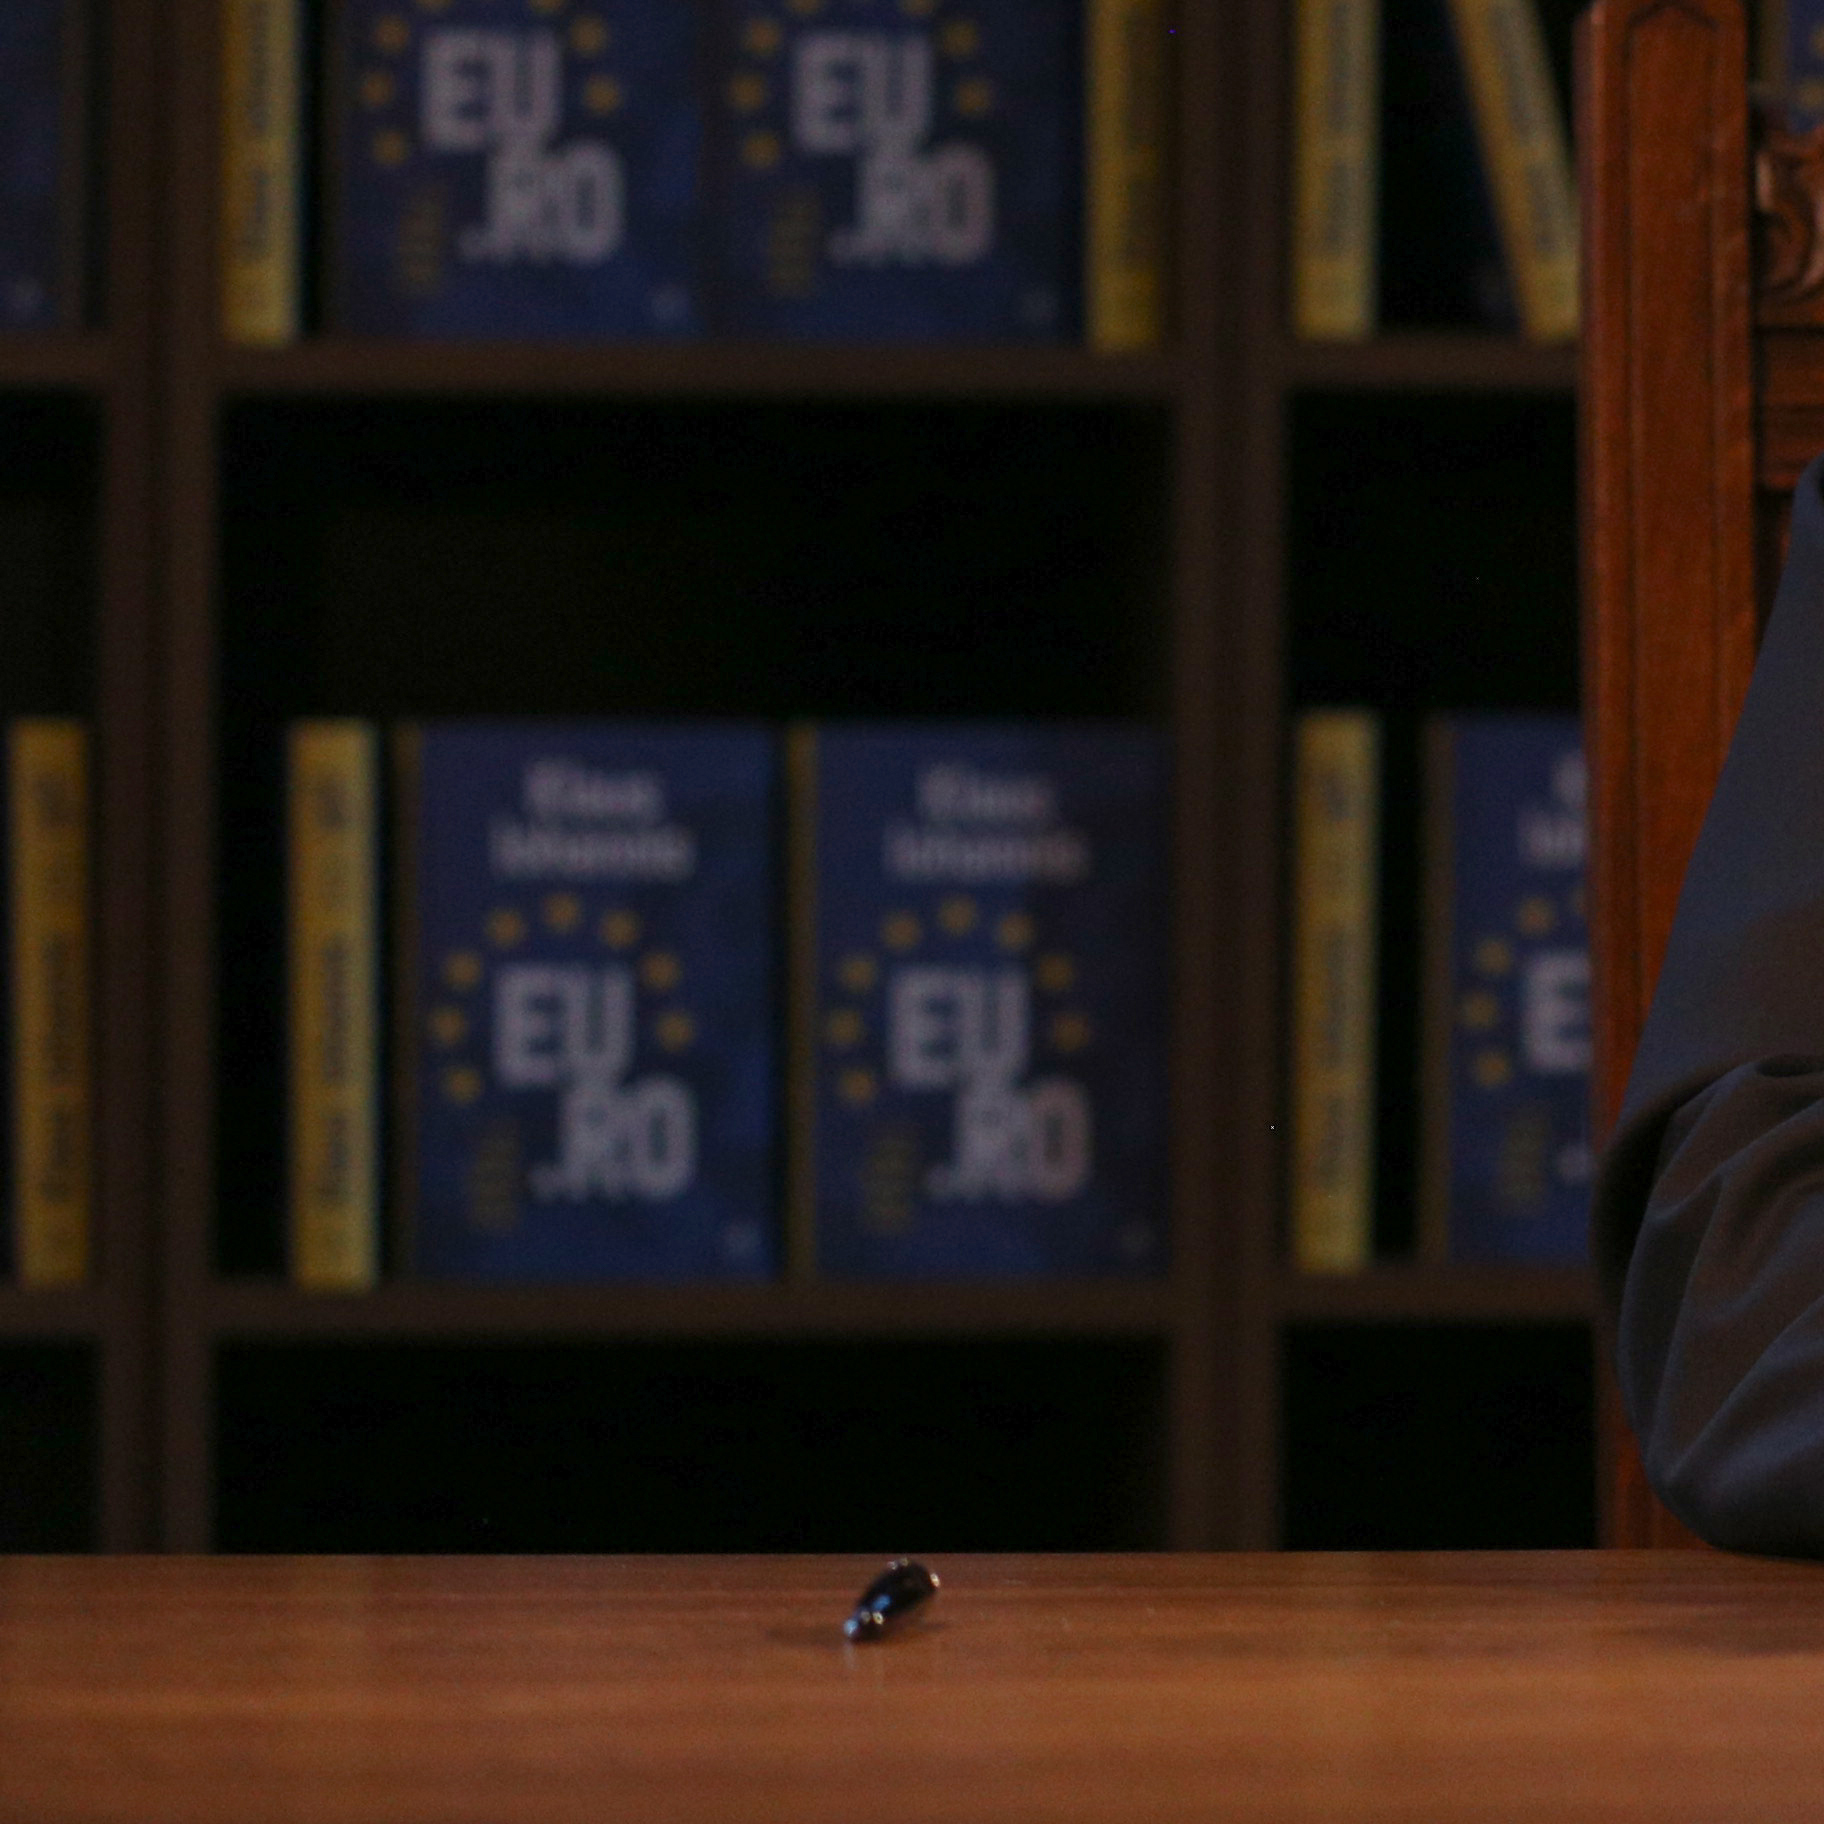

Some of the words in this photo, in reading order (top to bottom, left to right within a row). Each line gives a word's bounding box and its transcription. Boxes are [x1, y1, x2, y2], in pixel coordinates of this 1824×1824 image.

[425, 34, 558, 148] EU
[798, 36, 932, 149] EU
[497, 966, 632, 1083] EU
[892, 970, 1026, 1085] EU
[1525, 954, 1591, 1070] E
